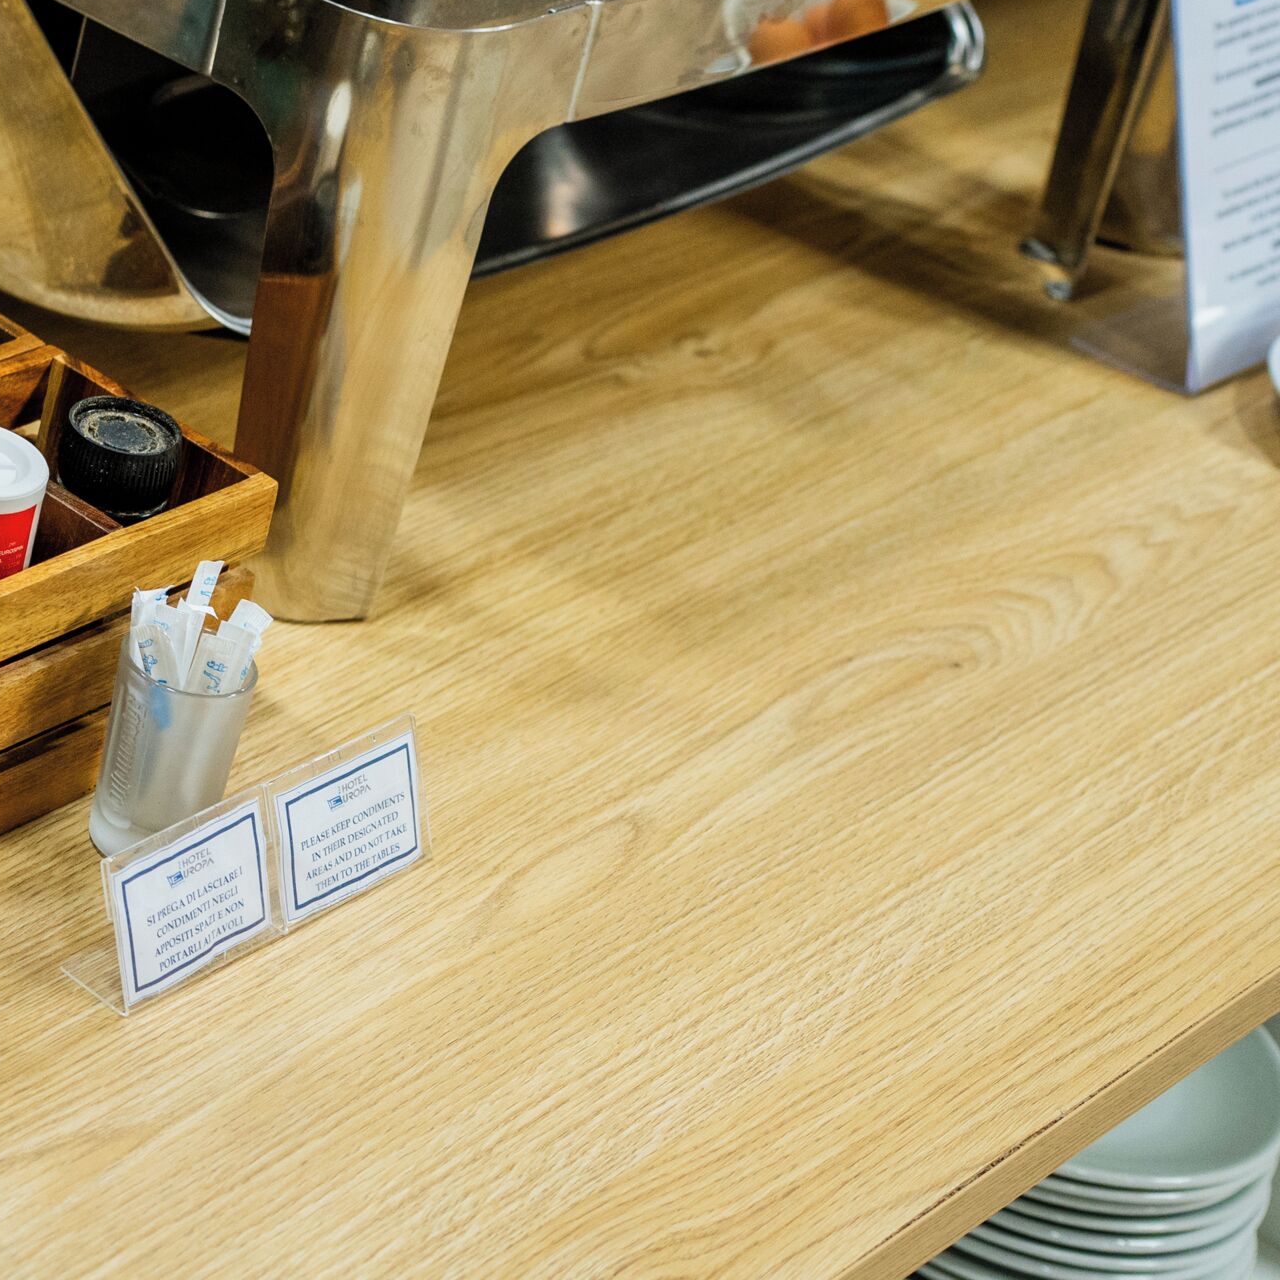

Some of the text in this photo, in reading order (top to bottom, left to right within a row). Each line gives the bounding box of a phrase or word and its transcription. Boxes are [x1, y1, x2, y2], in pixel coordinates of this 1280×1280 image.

[342, 773, 368, 793] HOTEL
[300, 791, 405, 851] PLEASE KEEP CONDIMENTS
[312, 811, 399, 862] IN THEIR DESIGNATED
[182, 848, 212, 868] HOTEL
[306, 823, 408, 880] AREAS AND DO NOT TAKE
[316, 842, 400, 892] THEM TO THE TABLES
[147, 914, 156, 926] SI
[157, 900, 185, 921] PREGA
[186, 891, 196, 904] DI
[197, 868, 239, 898] LASCIARE
[157, 885, 239, 938] CONDIMENTI NEGLI
[155, 928, 194, 957] APPOSITI
[195, 914, 216, 935] SPAZI
[224, 898, 245, 916] NON
[159, 940, 201, 972] PORTARLI
[212, 915, 244, 940] TAVOLI
